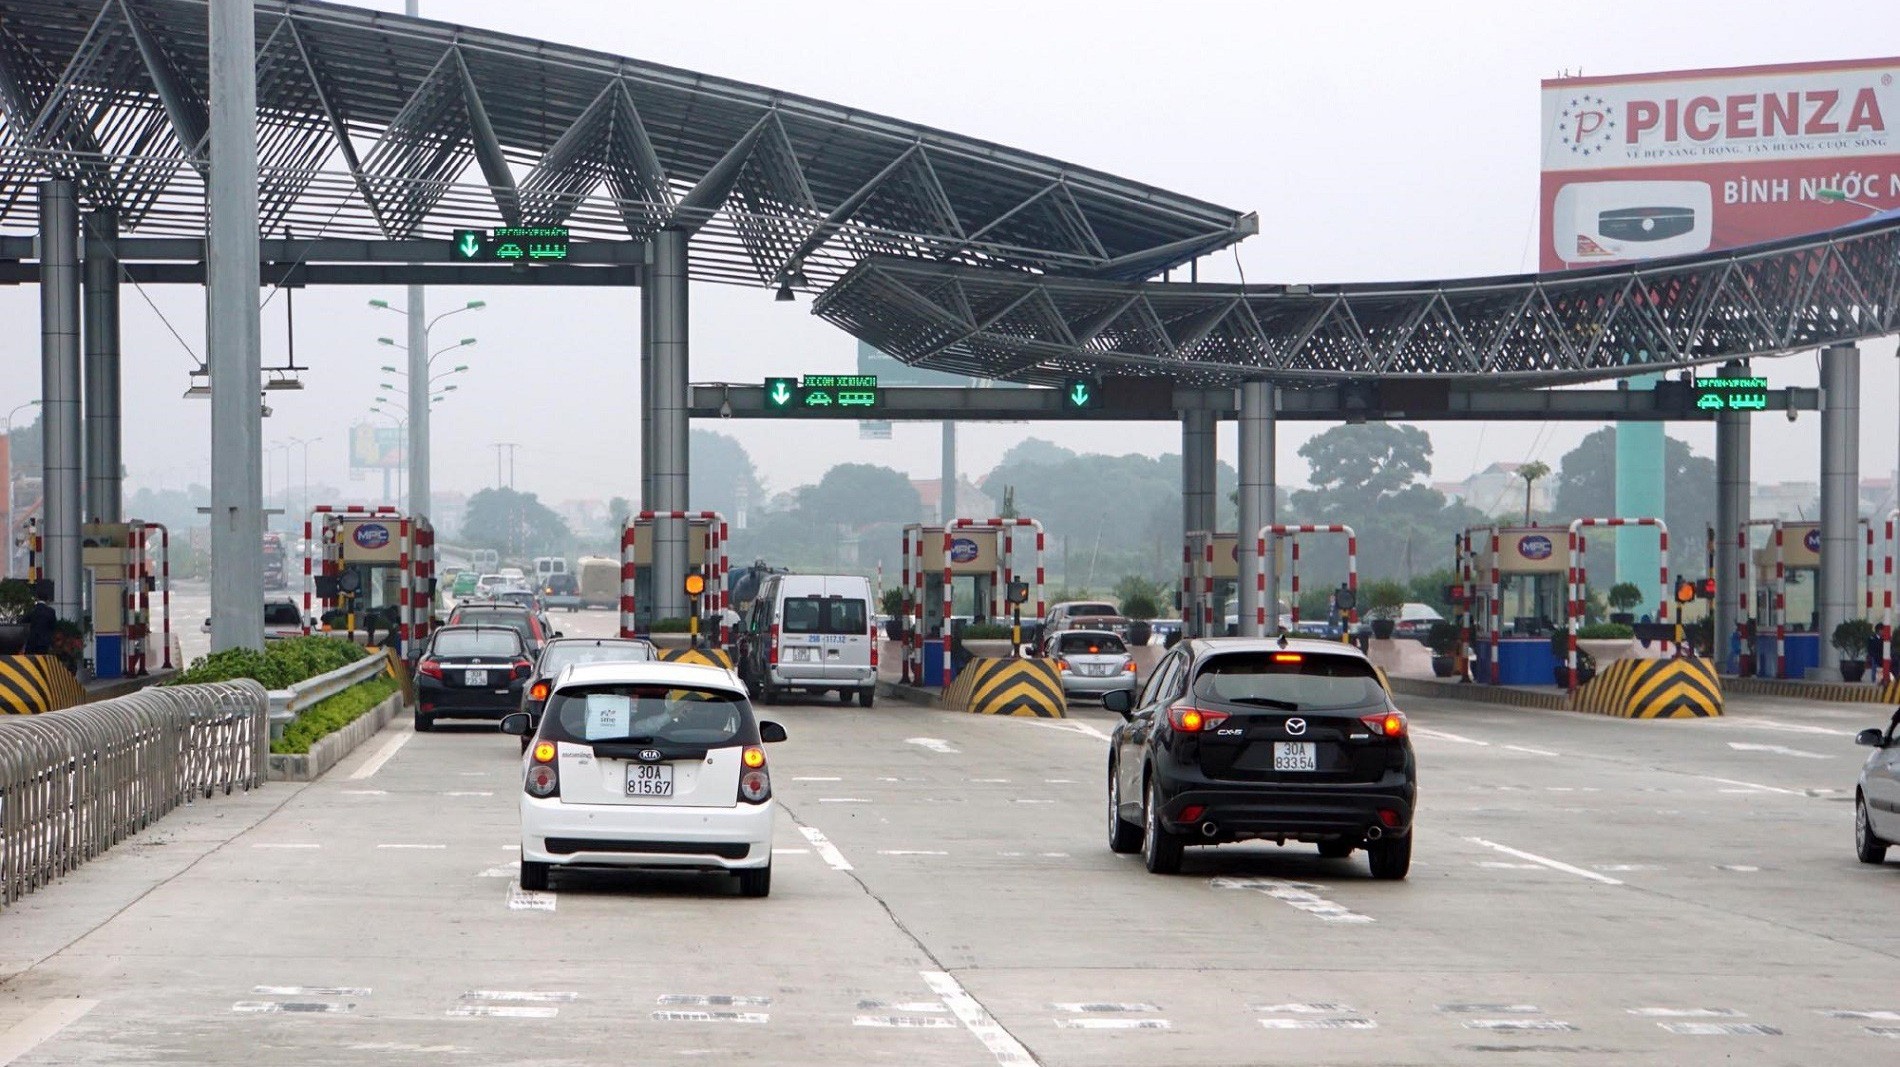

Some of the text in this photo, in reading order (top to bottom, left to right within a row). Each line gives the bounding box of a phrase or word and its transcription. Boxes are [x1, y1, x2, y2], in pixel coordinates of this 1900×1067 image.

[1626, 87, 1885, 144] PICENZA
[1724, 175, 1789, 204] BÌNH
[357, 530, 387, 541] MPC
[642, 751, 658, 759] KIA
[1284, 742, 1306, 756] 30A
[637, 765, 661, 780] 30A
[627, 780, 671, 795] 815.67
